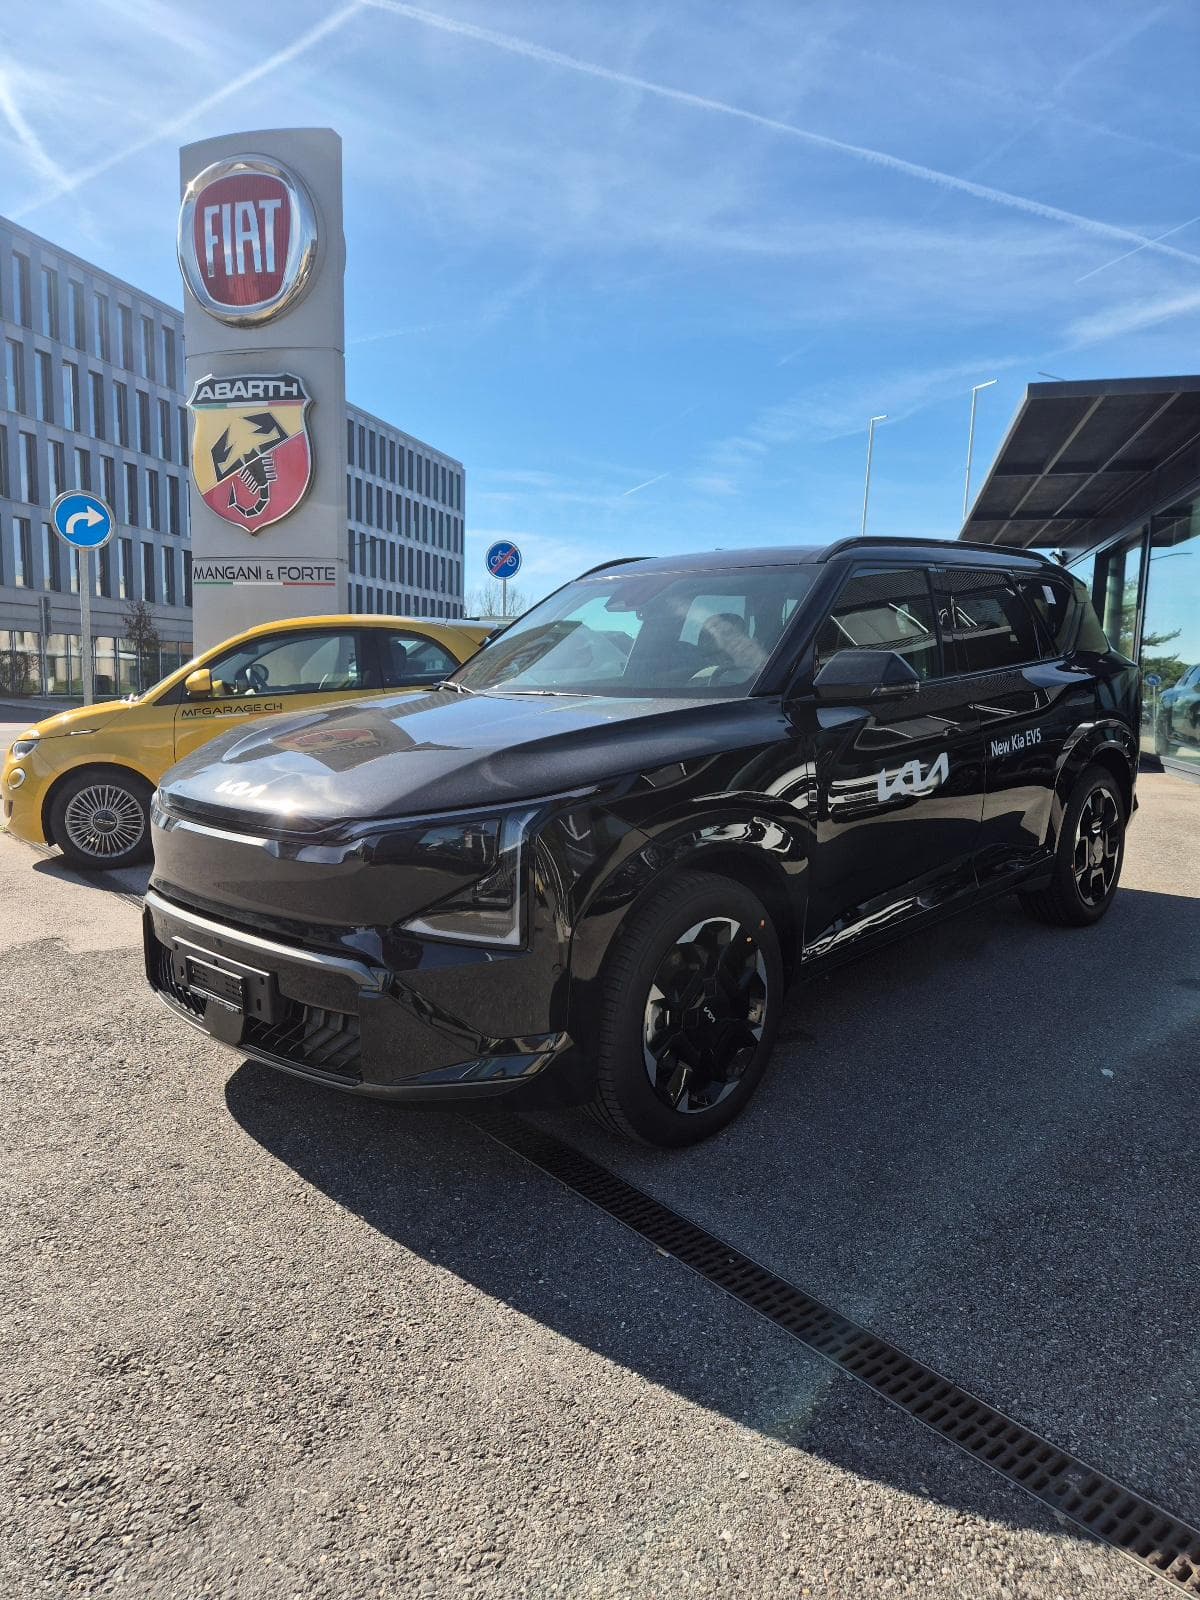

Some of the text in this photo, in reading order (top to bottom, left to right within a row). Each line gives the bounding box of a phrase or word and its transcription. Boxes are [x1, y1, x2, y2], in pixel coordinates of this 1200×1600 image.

[204, 198, 281, 278] FIAT
[197, 380, 298, 400] ABARTH
[193, 566, 336, 580] MANGANI & FORTE
[990, 727, 1042, 757] New Kia EV5
